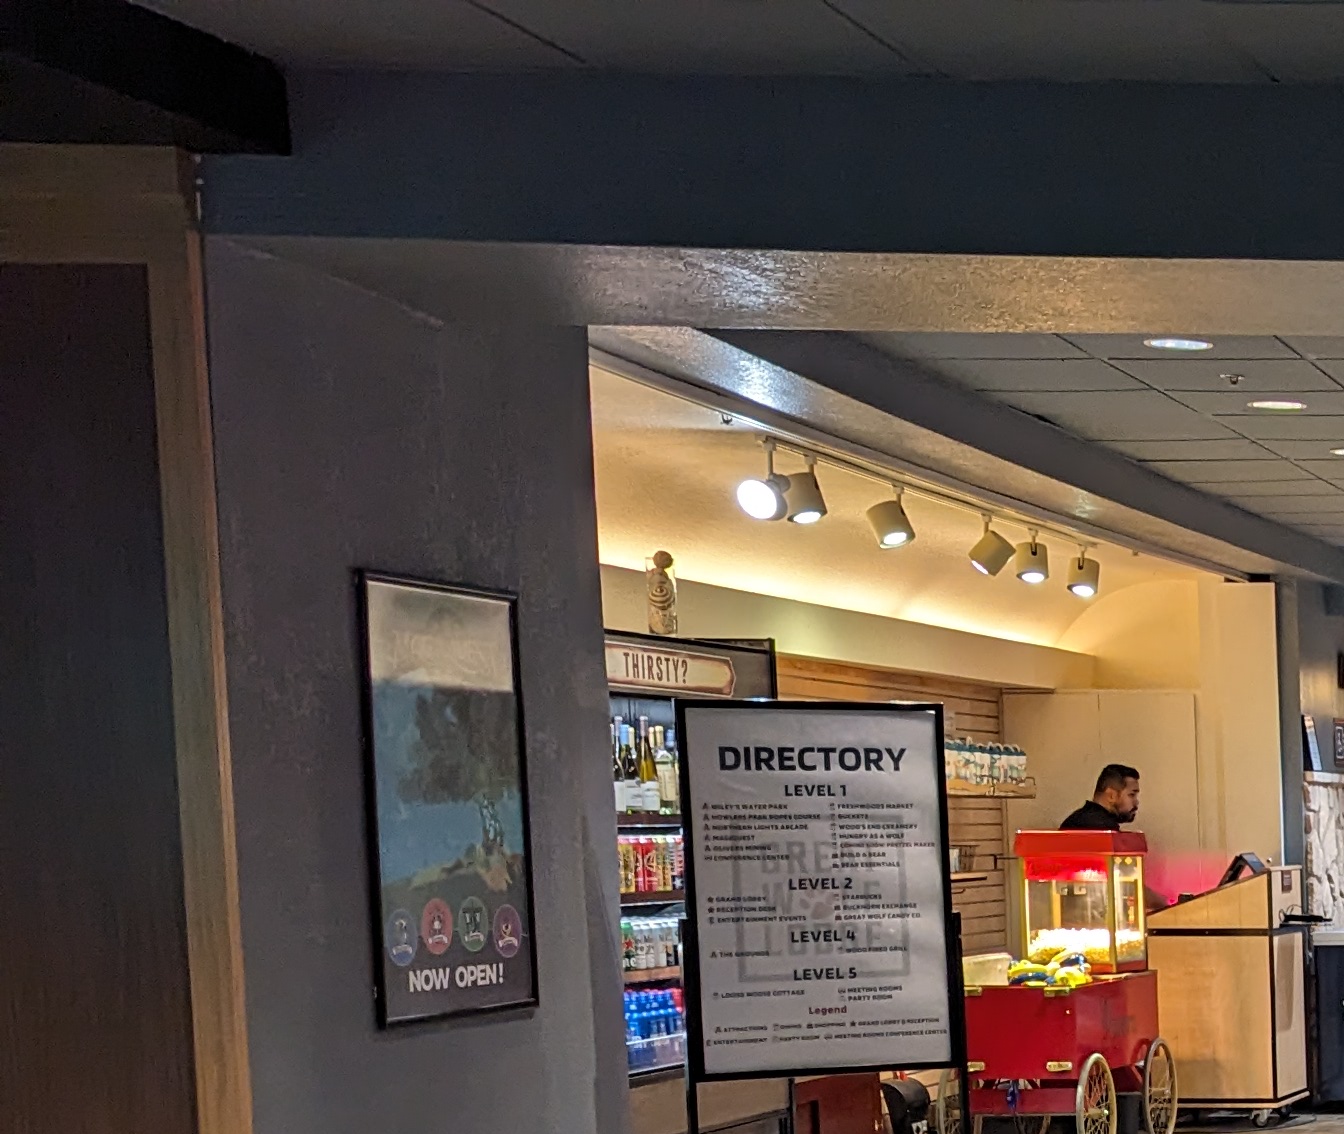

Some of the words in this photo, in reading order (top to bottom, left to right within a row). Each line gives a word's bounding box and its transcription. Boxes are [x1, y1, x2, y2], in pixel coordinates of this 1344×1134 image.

[623, 652, 688, 684] THIRSTY?
[718, 746, 906, 772] DIRECTORY
[784, 784, 836, 797] LEVEL
[840, 784, 847, 797] 1
[789, 878, 839, 890] LEVEL
[844, 878, 852, 889] 2
[791, 930, 842, 943] LEVEL
[846, 930, 855, 941] 4
[408, 967, 450, 993] NOW
[455, 963, 504, 988] OPEN!
[793, 968, 844, 981] LEVEL
[848, 967, 857, 979] 5
[809, 1006, 847, 1016] Legend
